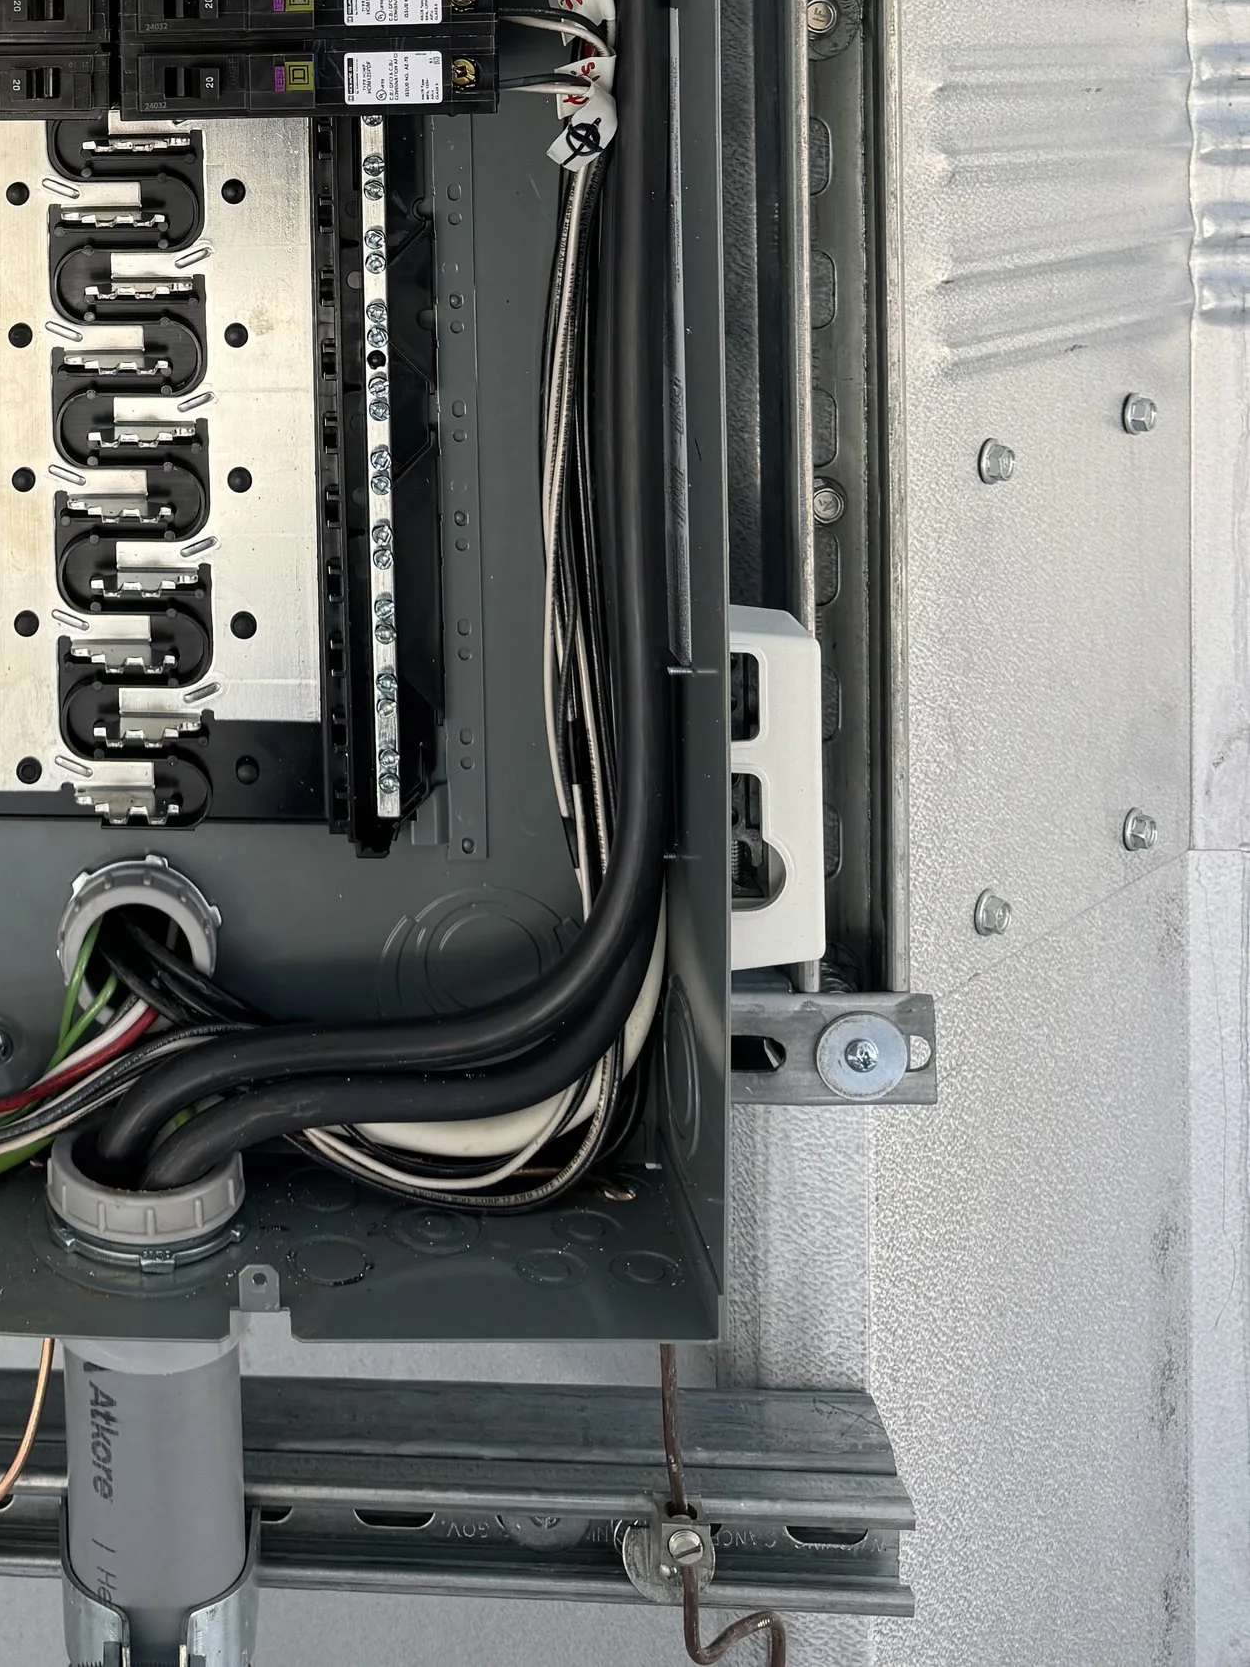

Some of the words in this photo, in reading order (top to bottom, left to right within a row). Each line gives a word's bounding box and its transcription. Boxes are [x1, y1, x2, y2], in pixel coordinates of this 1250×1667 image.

[13, 0, 21, 13] 20
[146, 23, 168, 31] 24032
[12, 80, 21, 92] 20
[205, 77, 214, 89] 20
[145, 102, 167, 110] 24032
[87, 1379, 120, 1501] Atkore
